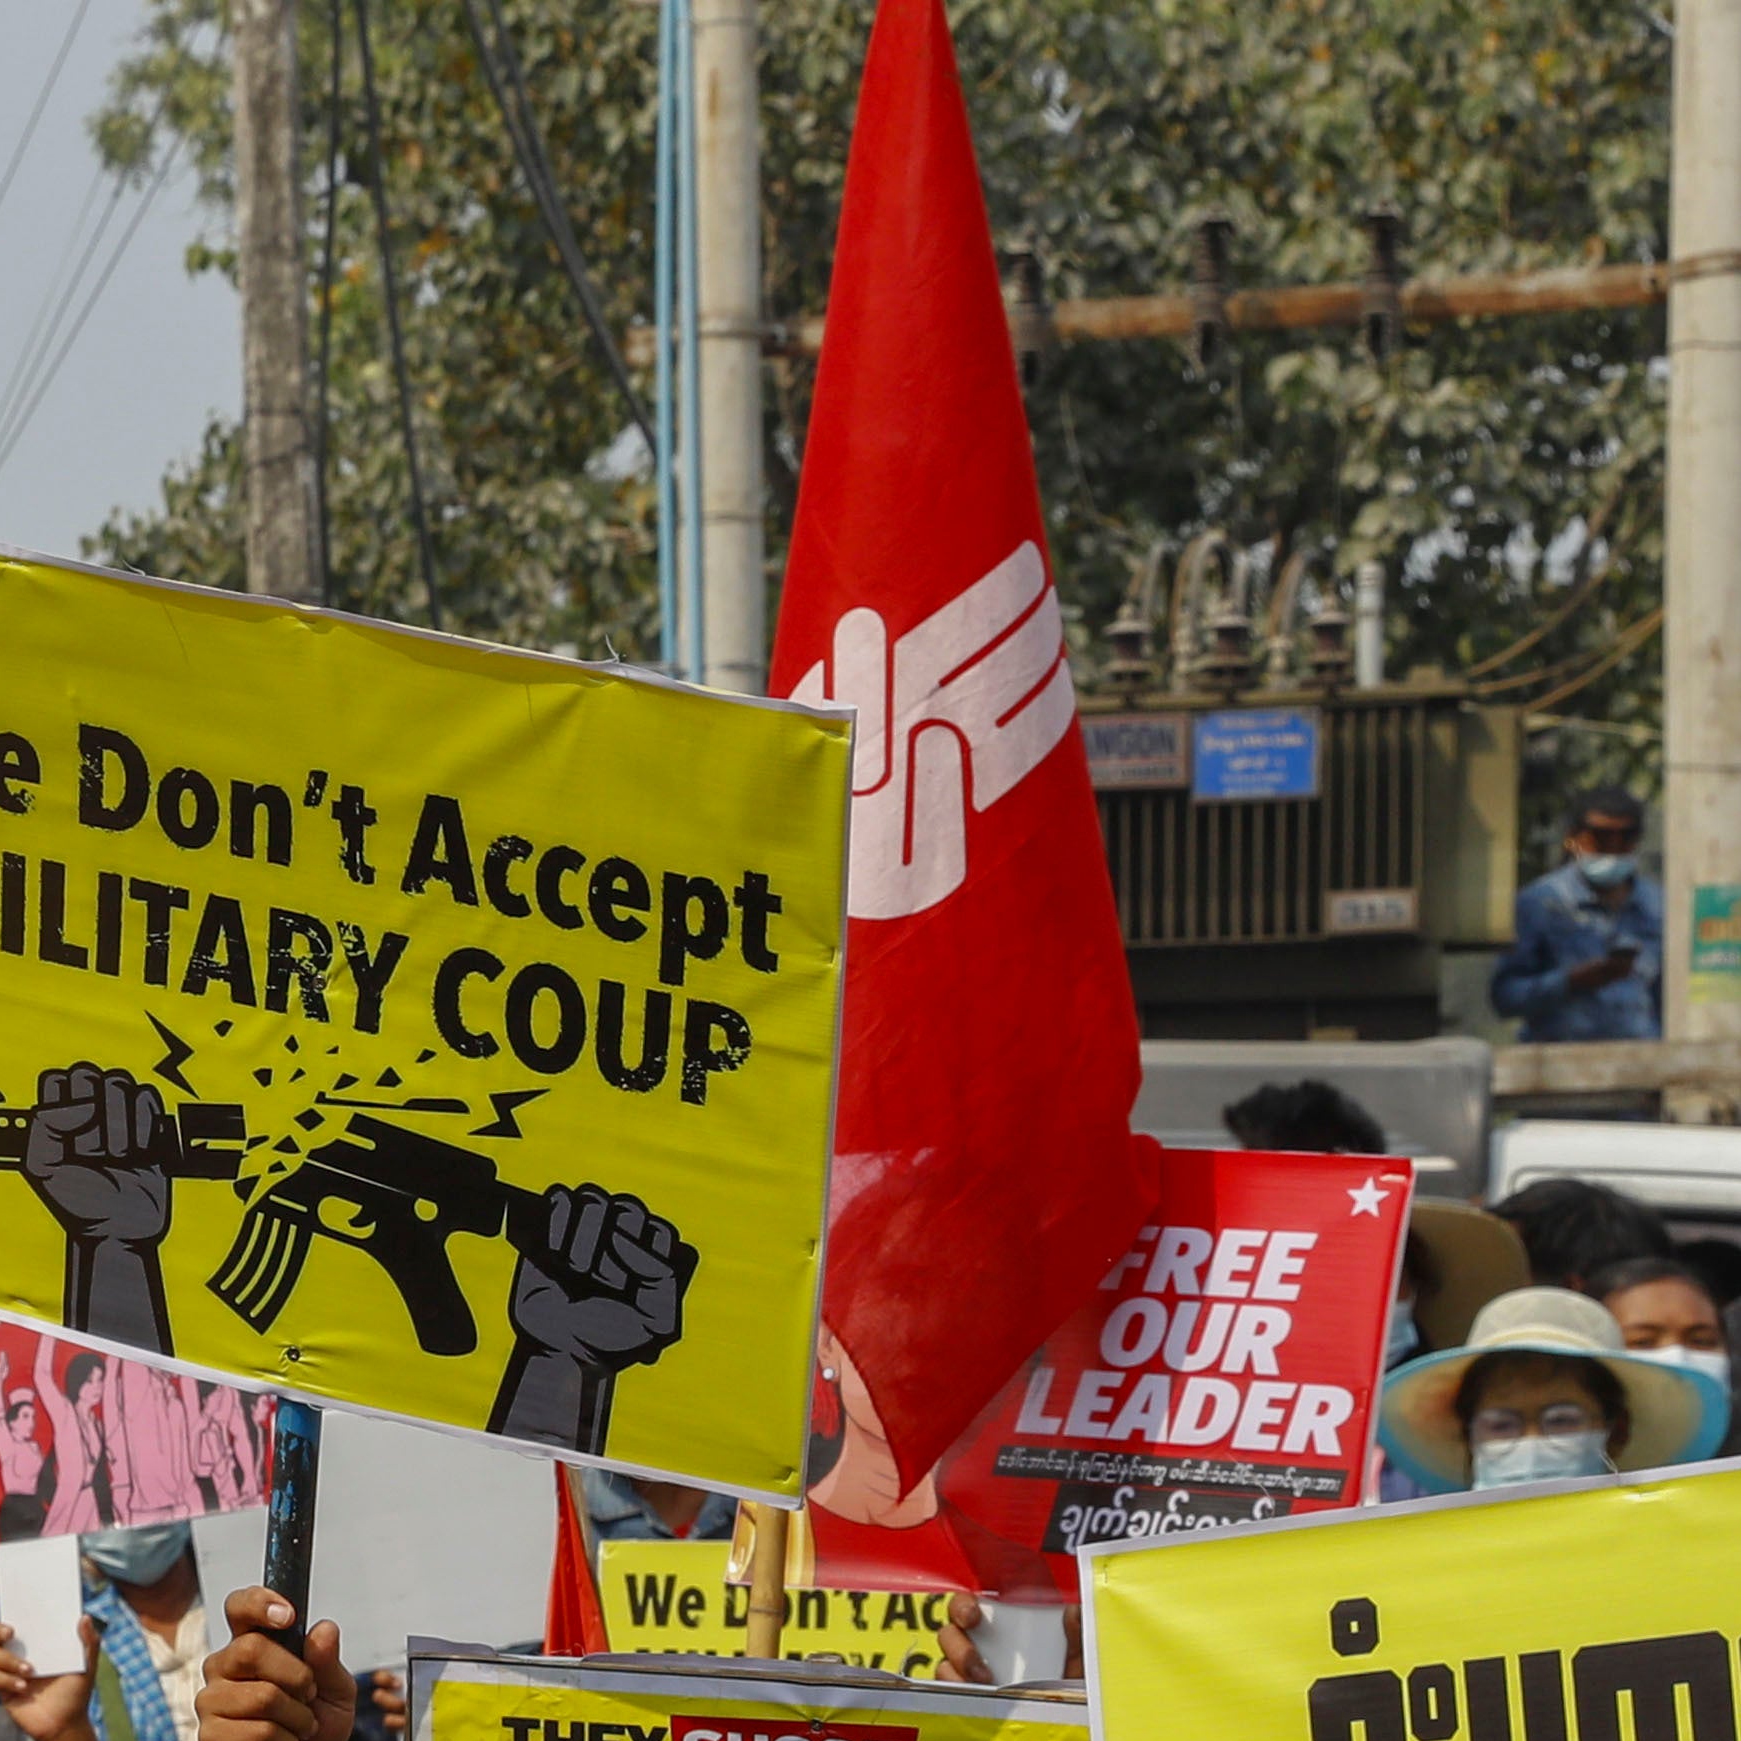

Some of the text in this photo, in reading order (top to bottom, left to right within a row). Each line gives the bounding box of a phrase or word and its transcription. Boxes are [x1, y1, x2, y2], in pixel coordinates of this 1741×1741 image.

[76, 720, 380, 887] Don't
[399, 793, 785, 988] Accept
[431, 947, 753, 1108] COUP
[1100, 1226, 1318, 1302] FREE
[1099, 1299, 1293, 1378] OUR
[1013, 1367, 1355, 1458] LEADER
[624, 1573, 707, 1628] We
